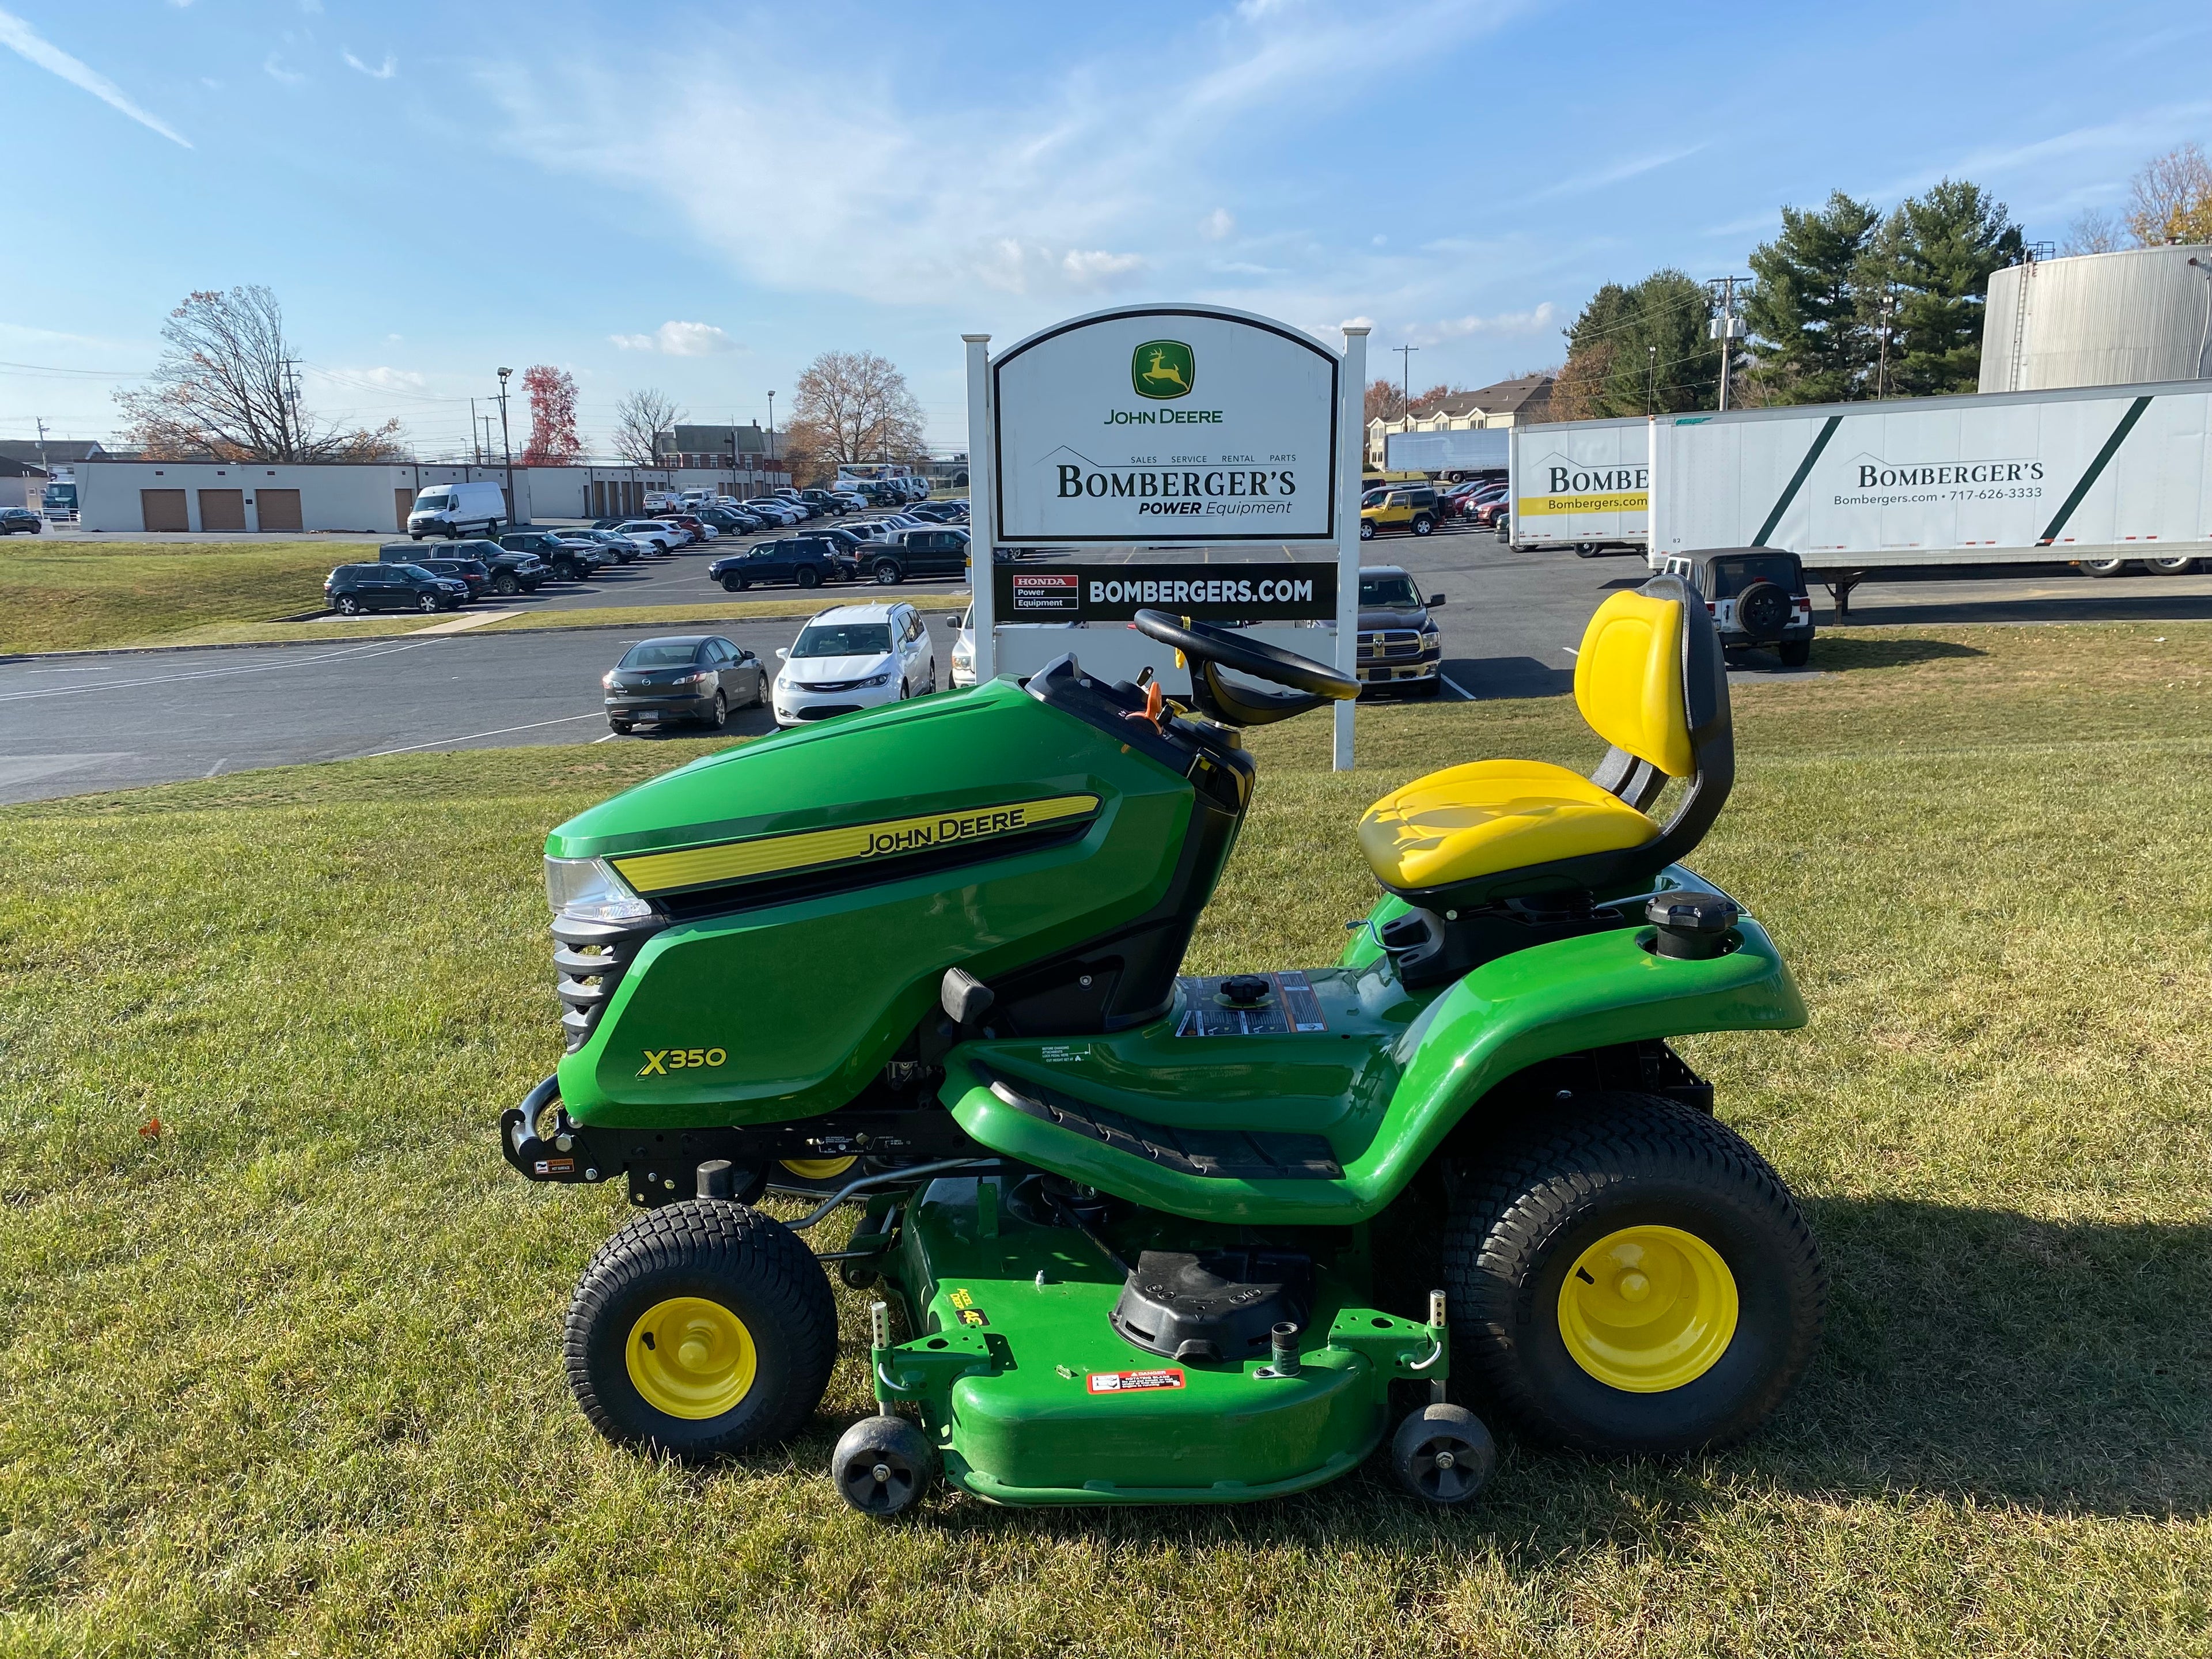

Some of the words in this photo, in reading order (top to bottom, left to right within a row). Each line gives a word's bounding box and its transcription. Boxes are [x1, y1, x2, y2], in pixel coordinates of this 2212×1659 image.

[1104, 409, 1155, 425] JOHN
[1160, 408, 1223, 423] DEERE
[1056, 464, 1296, 498] BOMBERGER'S
[1858, 463, 2044, 487] BOMBERGER'S
[1549, 498, 1647, 510] Bombergers.com
[1834, 493, 1937, 506] Bombergers.com
[1950, 487, 2042, 501] 717-626-3333
[1139, 502, 1202, 515] POWER
[1206, 501, 1293, 516] Equipment
[1017, 578, 1066, 586] HONDA
[1018, 588, 1044, 596] Power
[1090, 580, 1312, 603] BOMBERGERS.COM
[1018, 599, 1063, 607] Equipment
[860, 827, 932, 856] JOHN
[939, 809, 1025, 840] DEERE
[640, 1047, 727, 1075] X350
